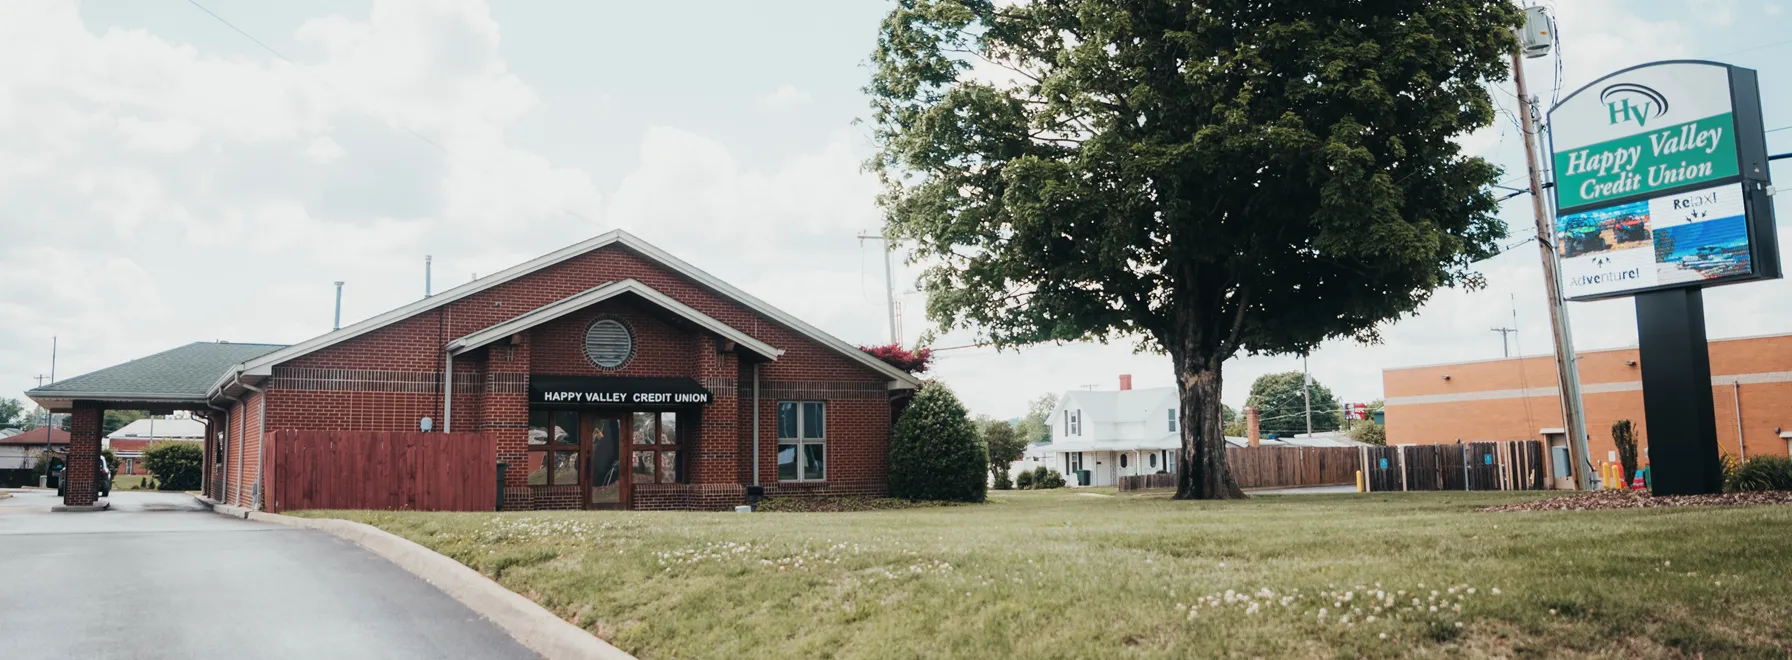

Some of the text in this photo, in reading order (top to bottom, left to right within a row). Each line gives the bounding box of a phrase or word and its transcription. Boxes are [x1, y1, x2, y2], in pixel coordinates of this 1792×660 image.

[1608, 98, 1651, 127] HV
[1565, 123, 1722, 176] Happy Valley
[1580, 161, 1712, 199] Credit Union
[1674, 192, 1717, 210] Relax!
[1569, 268, 1640, 287] Adventure!
[544, 392, 707, 403] HAPPY VALLEY CREDIT UNION
